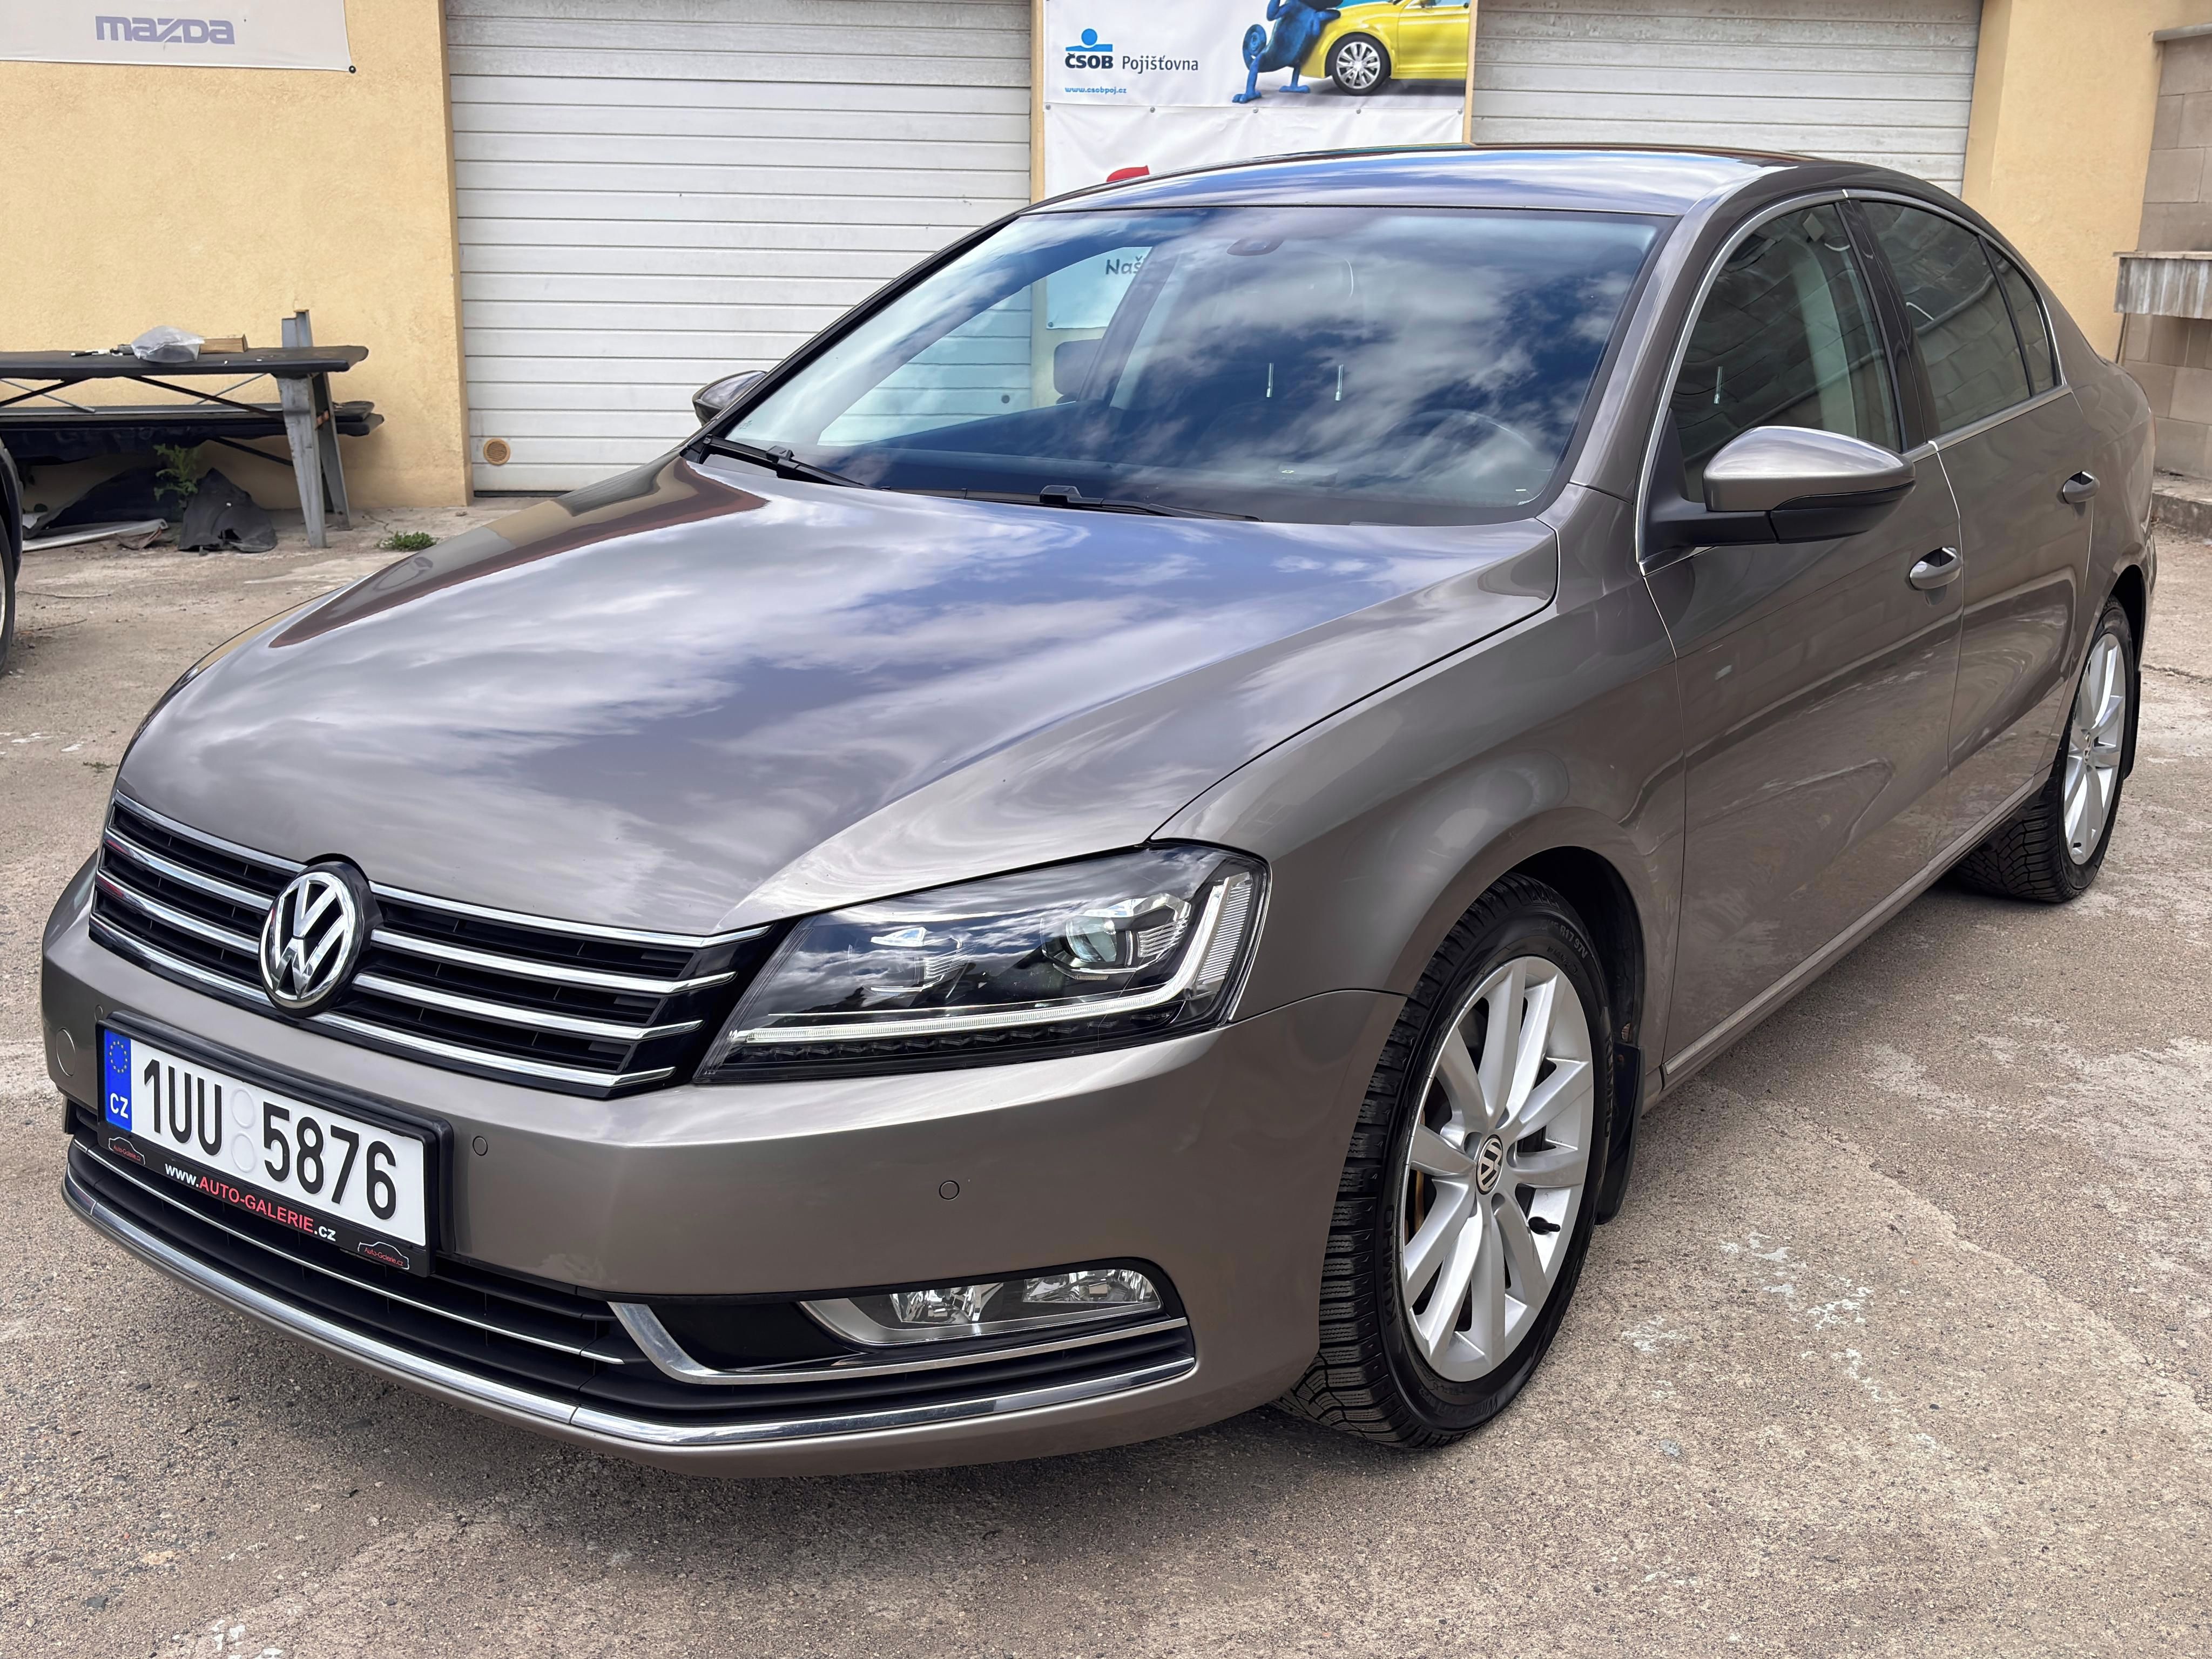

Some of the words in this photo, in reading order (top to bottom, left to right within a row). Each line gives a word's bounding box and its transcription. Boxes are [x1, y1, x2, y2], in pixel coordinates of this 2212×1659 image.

[1065, 52, 1114, 69] ČSOB
[1122, 55, 1198, 74] Pojišťovna
[110, 1092, 129, 1120] CZ
[143, 1058, 222, 1157] 1UU
[263, 1101, 397, 1221] 5876
[164, 1162, 336, 1243] www.AUTO-GALERIE.cz
